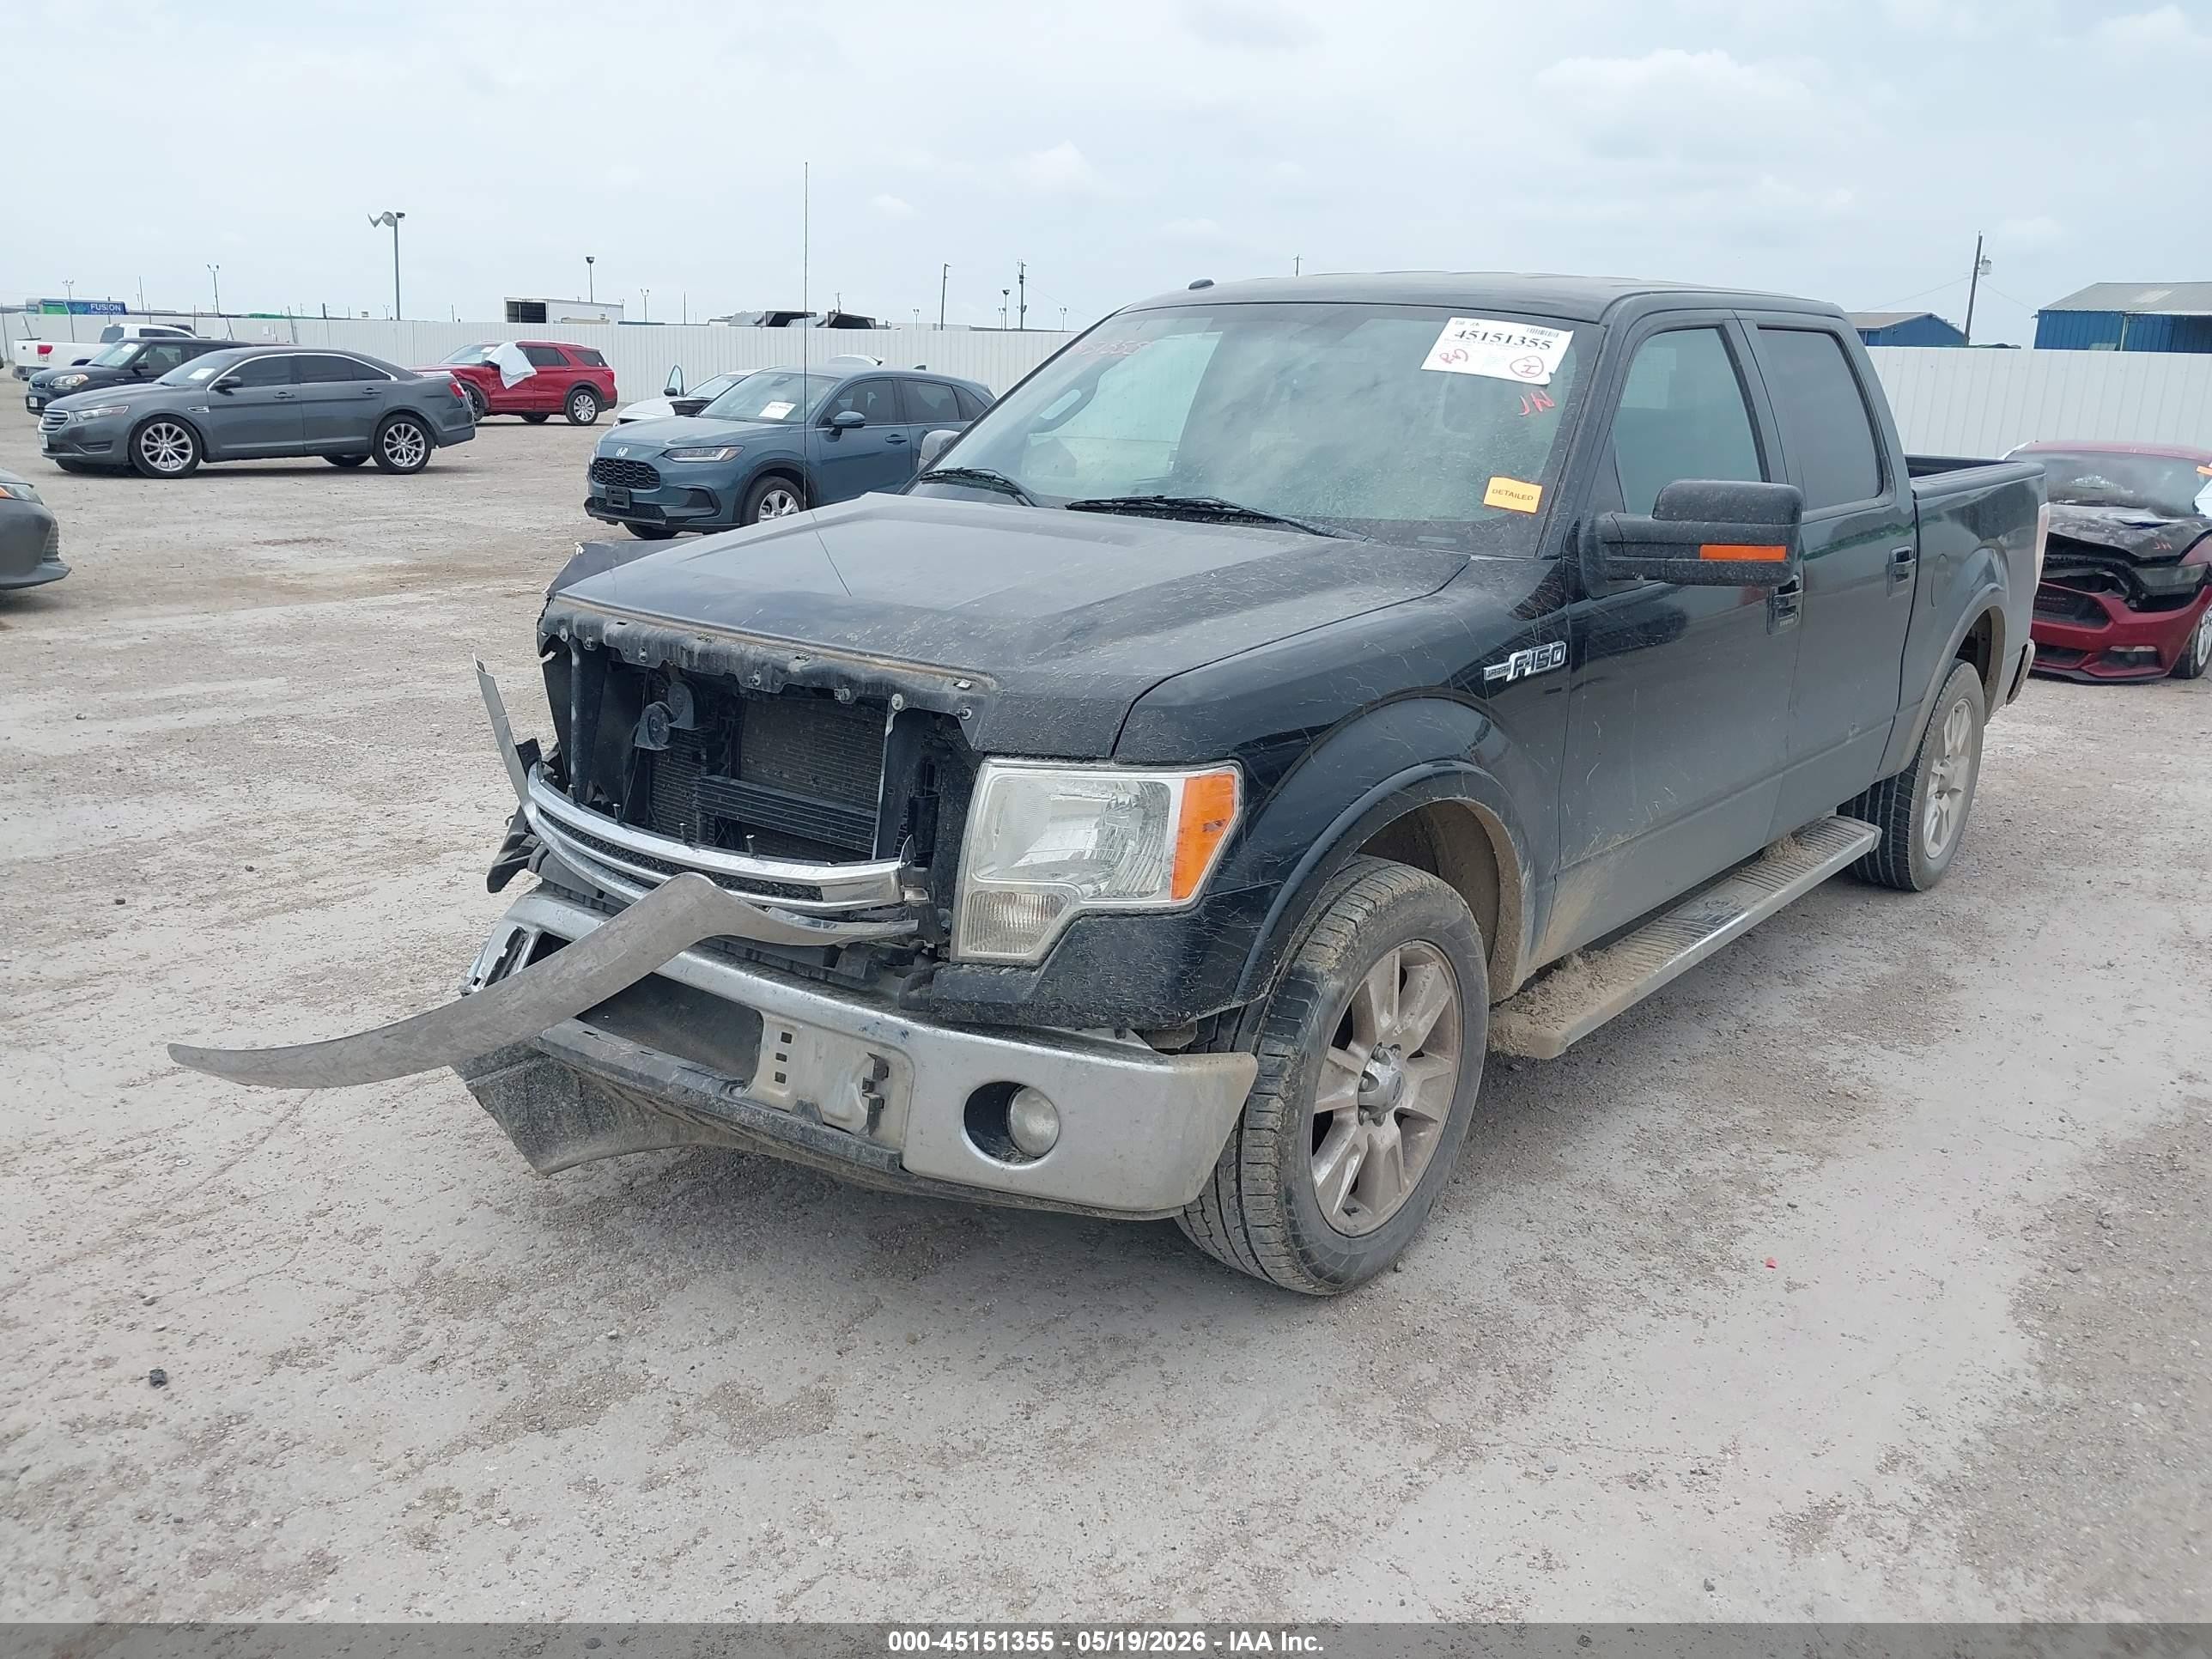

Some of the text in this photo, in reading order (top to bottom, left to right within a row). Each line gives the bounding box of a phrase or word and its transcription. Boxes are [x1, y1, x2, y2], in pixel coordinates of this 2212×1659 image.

[89, 302, 121, 312] FUSION
[1455, 330, 1553, 350] 45151355
[1492, 489, 1534, 501] DETAILED
